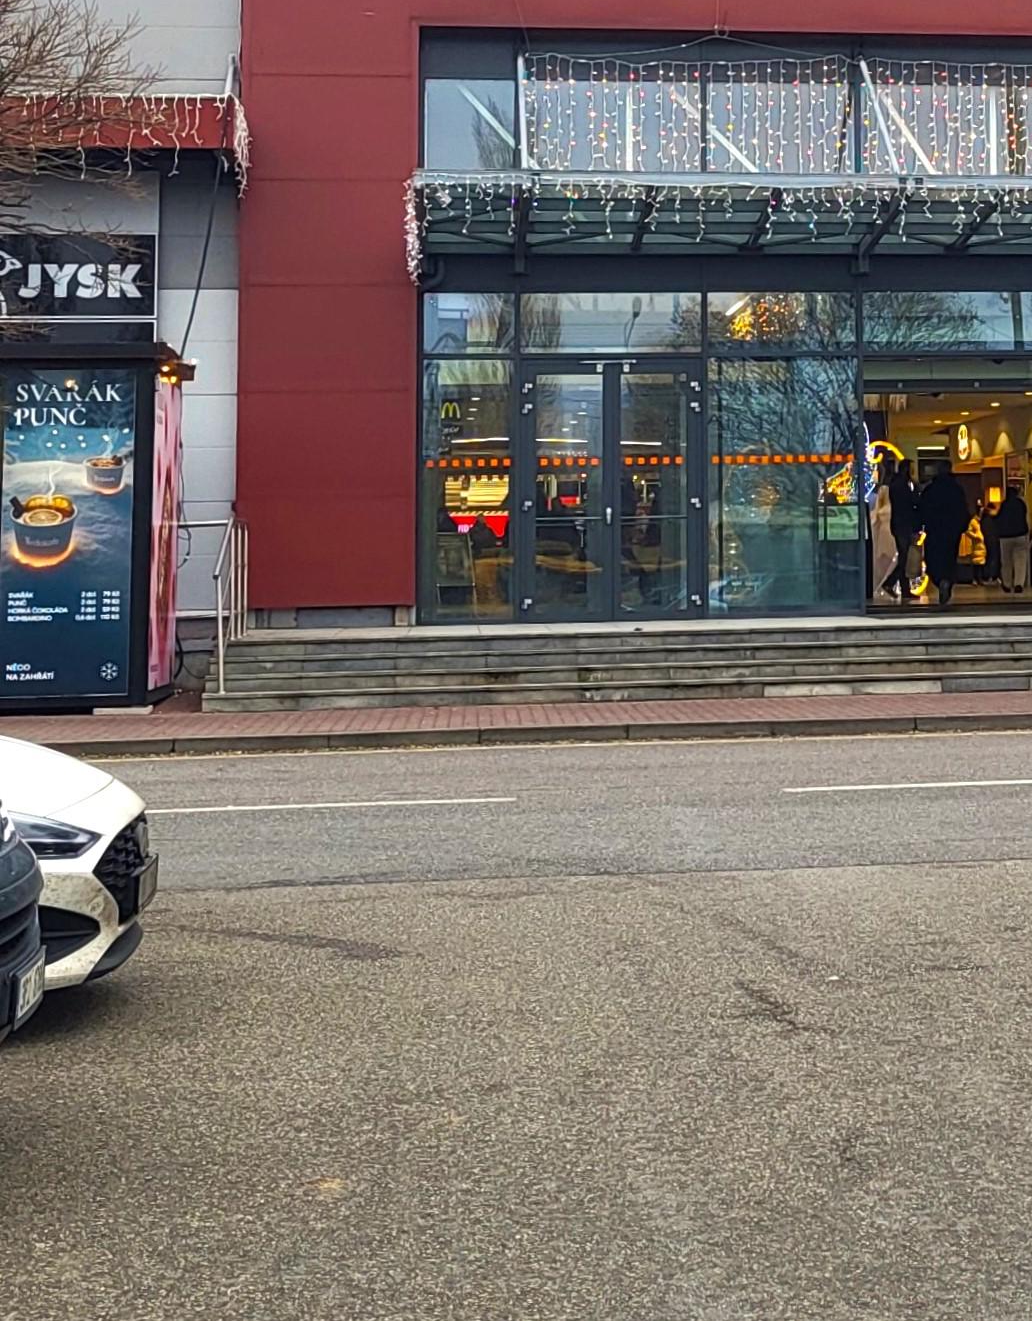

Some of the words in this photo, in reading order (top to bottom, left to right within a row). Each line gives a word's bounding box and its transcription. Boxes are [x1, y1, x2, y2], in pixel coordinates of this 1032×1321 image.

[18, 263, 143, 299] JYSK
[15, 404, 87, 427] PUNČ
[5, 673, 18, 681] NA
[19, 671, 54, 681] ZAHŘÁTÍ
